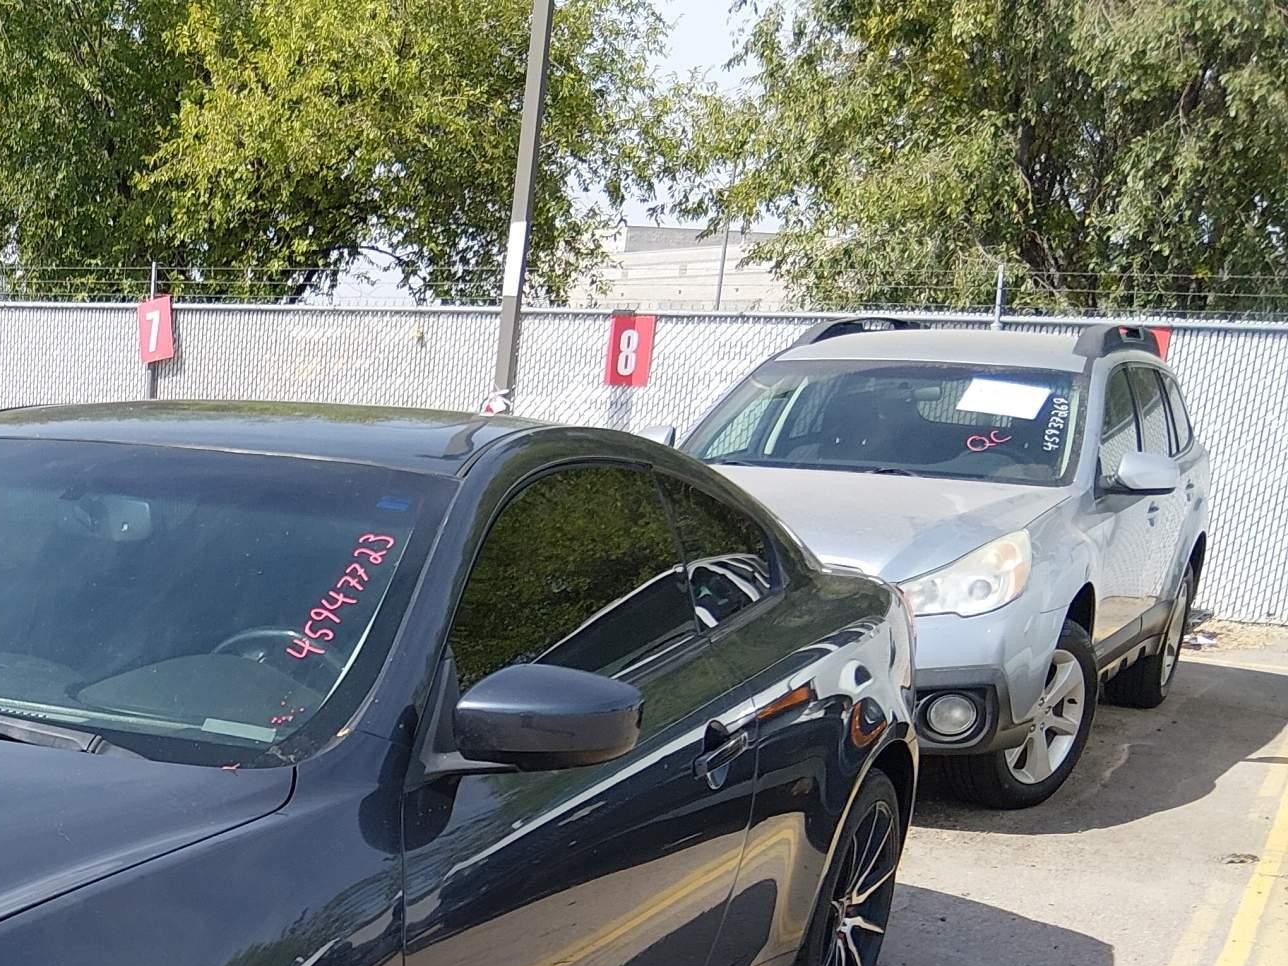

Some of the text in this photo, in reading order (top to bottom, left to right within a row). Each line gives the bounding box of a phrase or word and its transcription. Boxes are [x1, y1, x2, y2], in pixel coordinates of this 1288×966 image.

[146, 310, 160, 352] 7
[616, 329, 639, 376] 8
[286, 533, 395, 659] 45947723
